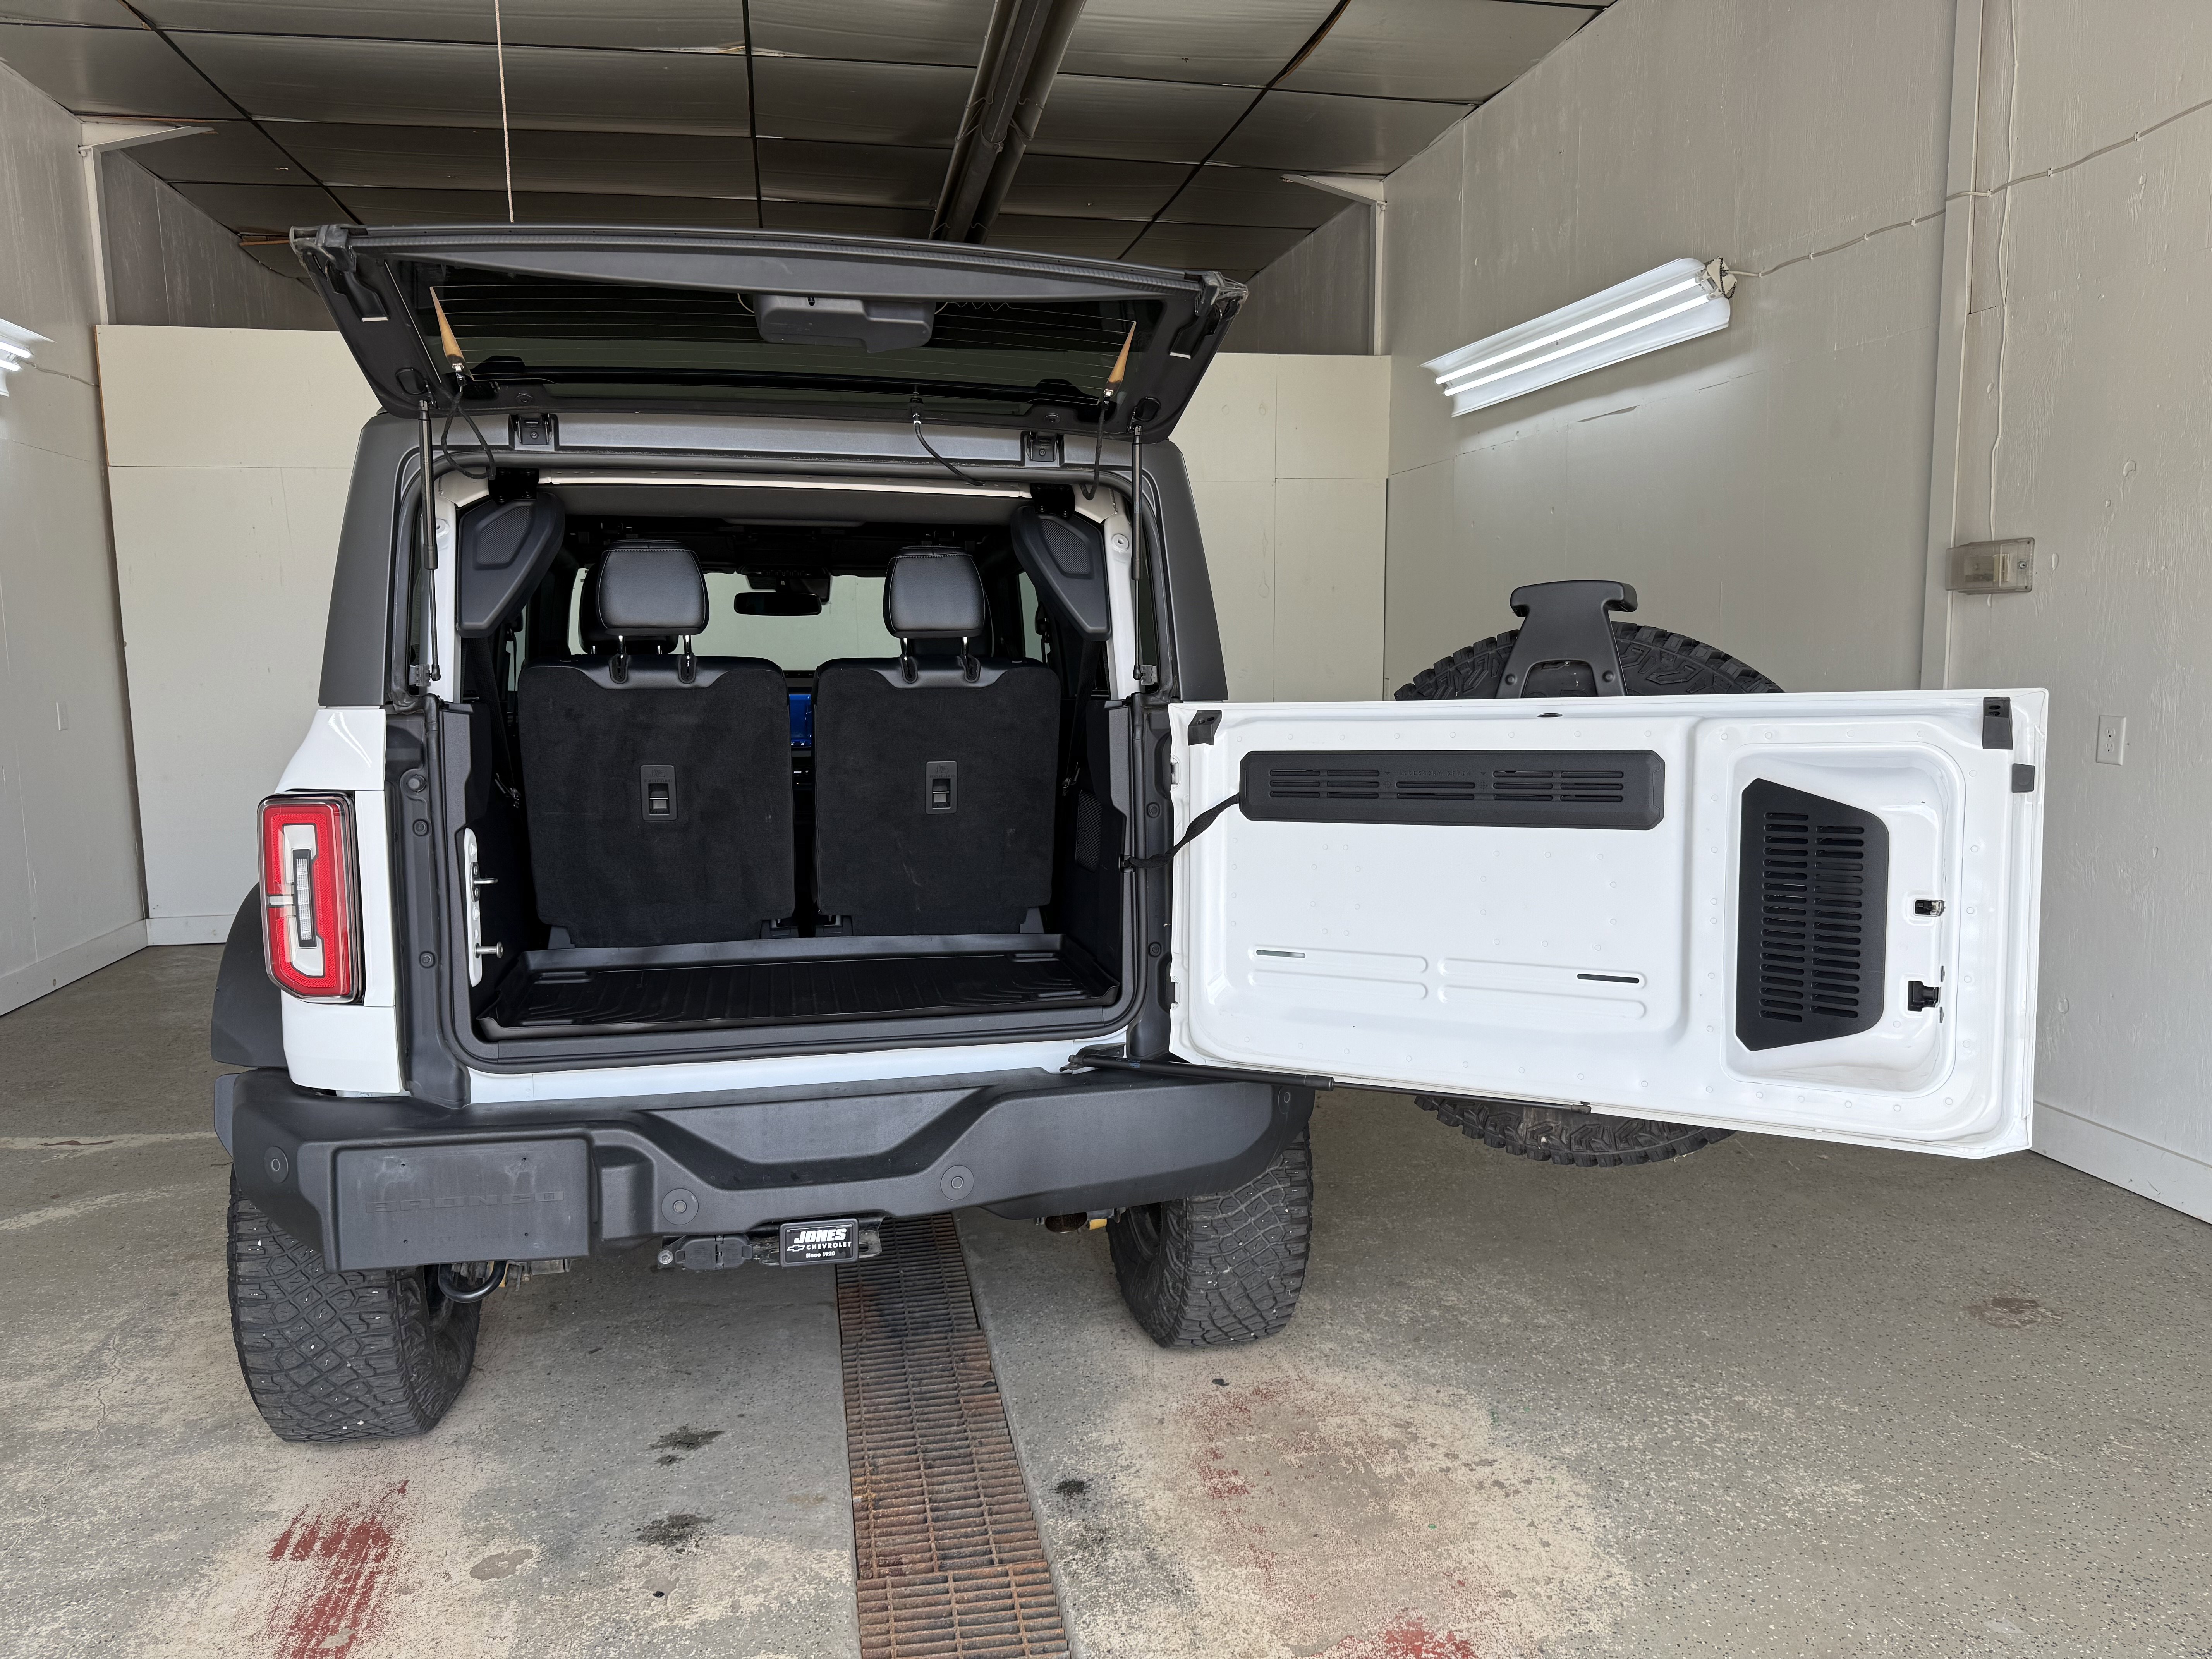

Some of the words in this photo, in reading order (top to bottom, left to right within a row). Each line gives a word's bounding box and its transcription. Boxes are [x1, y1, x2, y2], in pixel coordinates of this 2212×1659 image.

[366, 1191, 564, 1213] BRONCO
[794, 1228, 847, 1244] JONES
[806, 1241, 852, 1250] CHEVROLET
